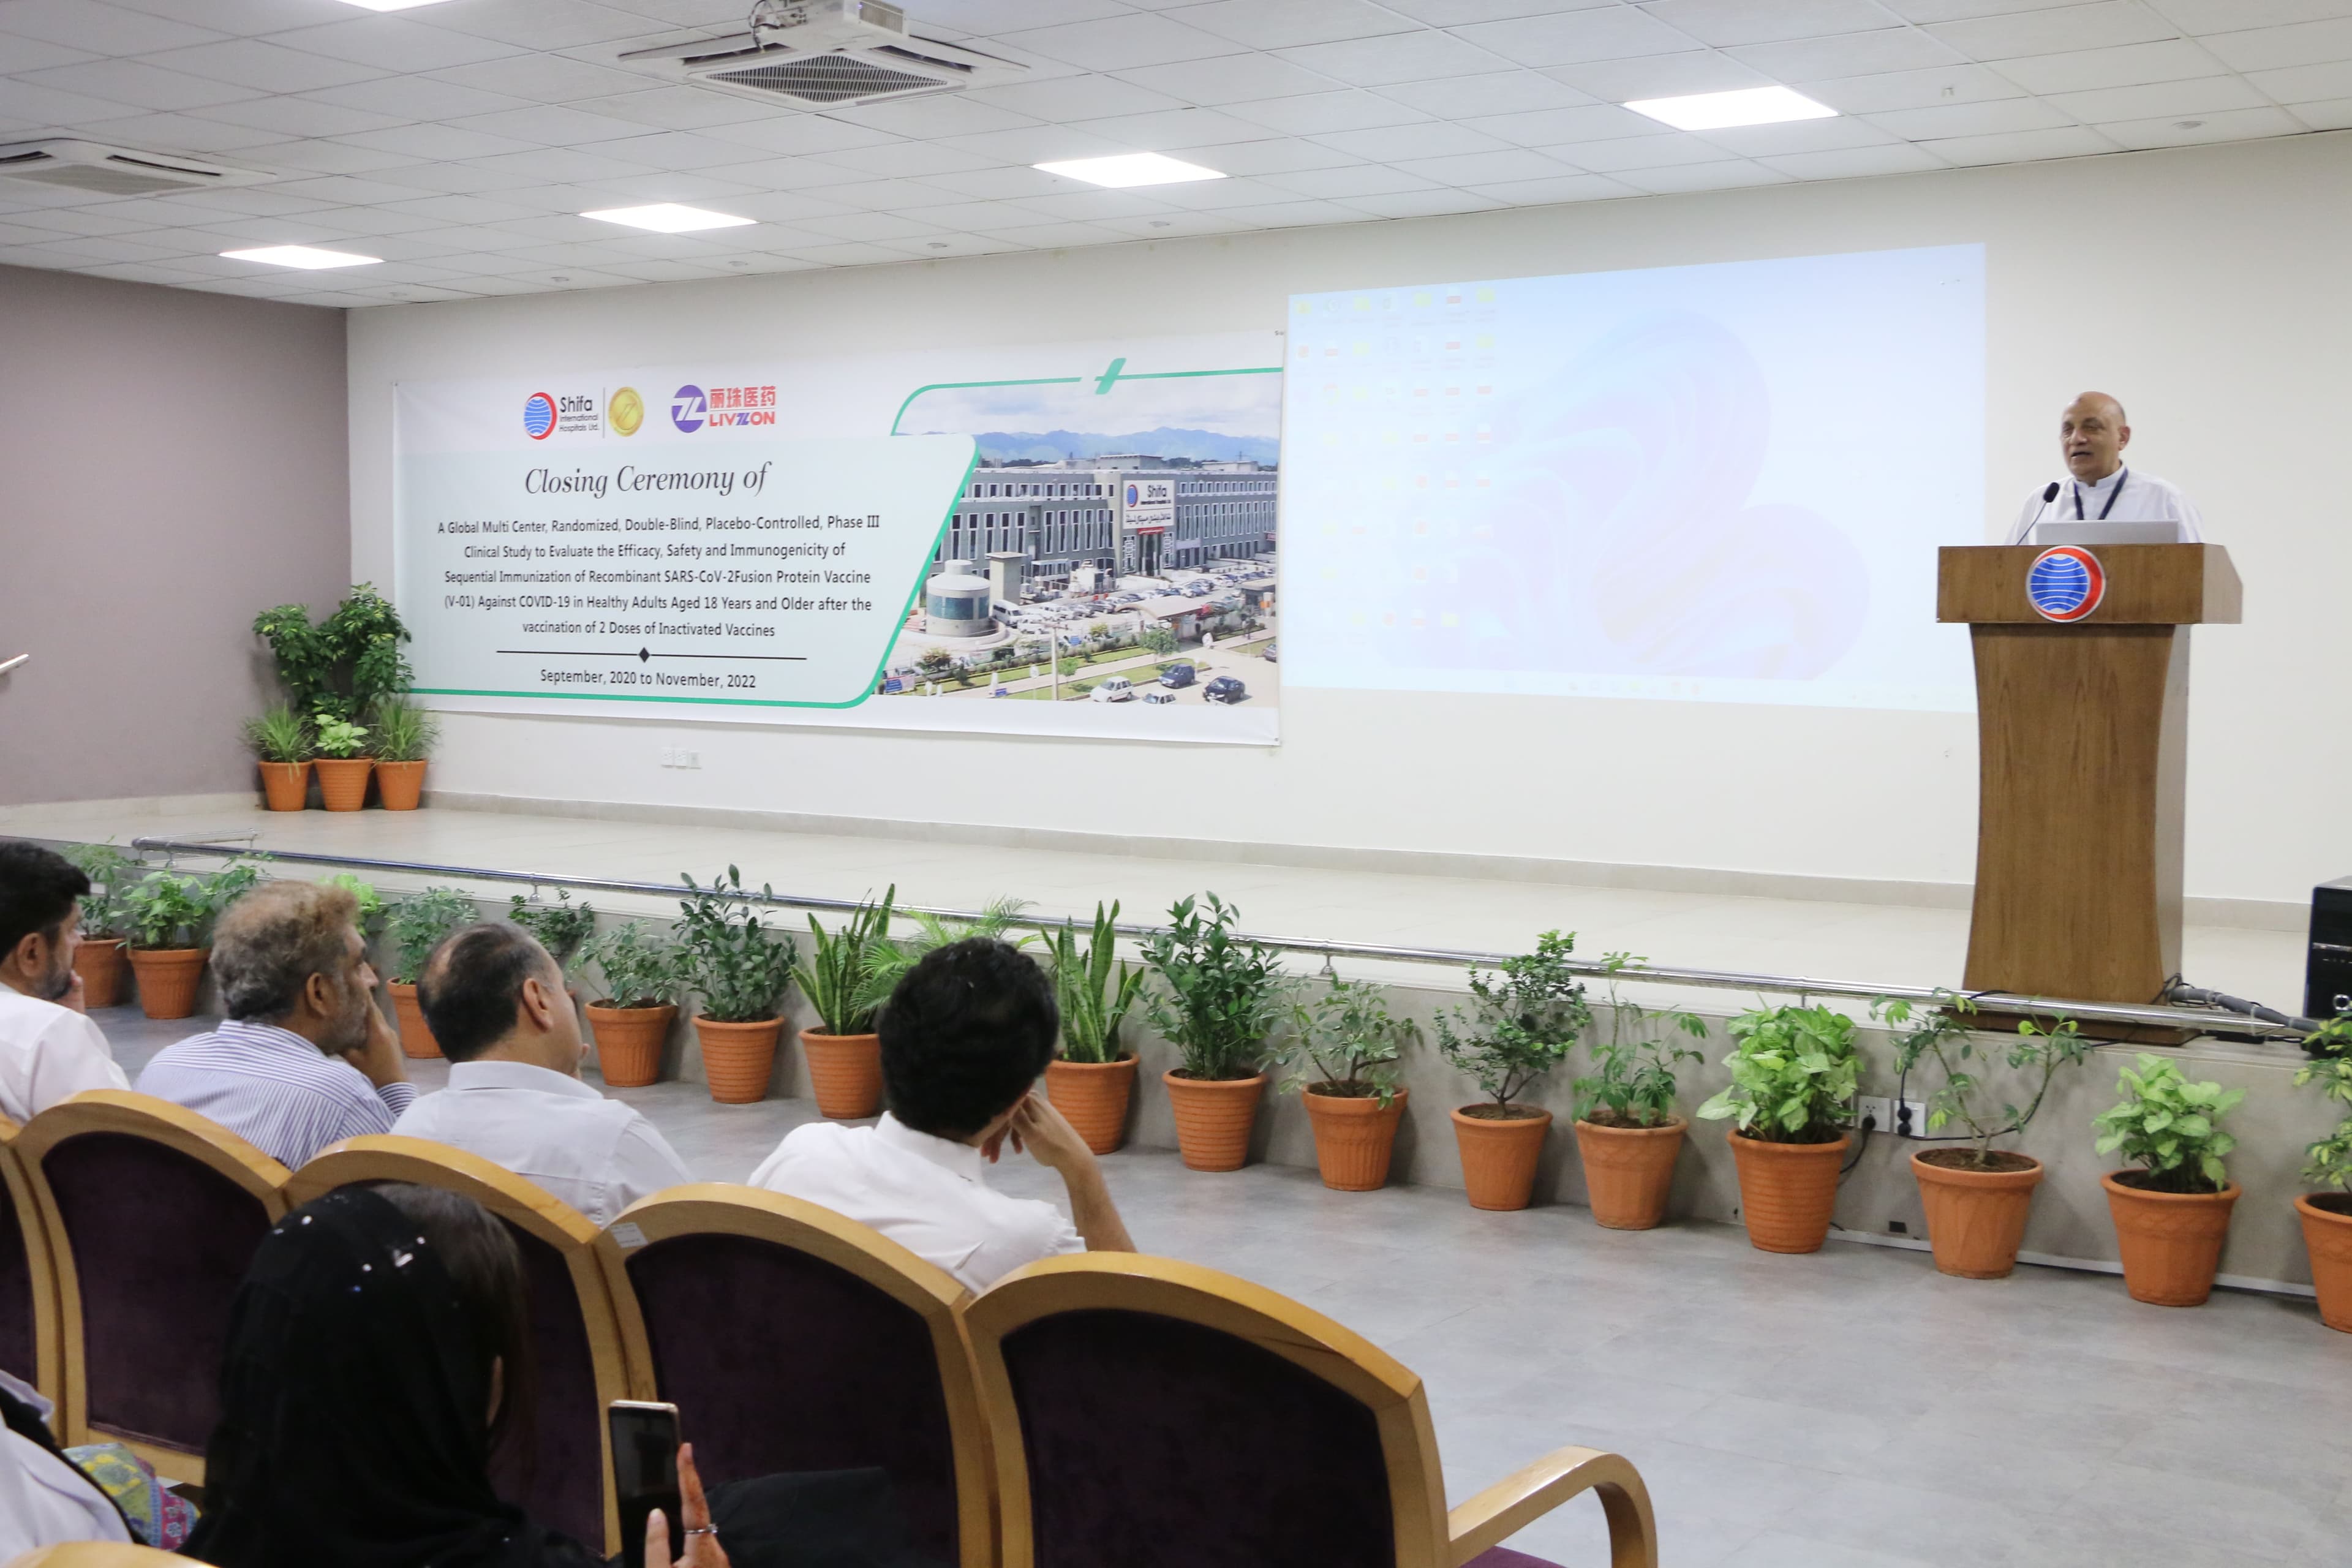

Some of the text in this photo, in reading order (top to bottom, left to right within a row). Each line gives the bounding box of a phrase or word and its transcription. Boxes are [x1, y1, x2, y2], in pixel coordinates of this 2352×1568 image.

[559, 396, 593, 413] Shifa
[710, 385, 777, 409] 丽珠医药
[524, 461, 773, 499] Closing Ceremony of
[437, 514, 880, 534] A Global Multi Center, Randomized, Double-Blind, Placebo-Controlled, Phase III
[464, 541, 846, 561] Clinical Study to Evaluate the Efficacy, Safety and Immunogenicity of
[444, 569, 871, 586] Sequential Immunization of Recombinant SARS-CoV-2Fusion Protein Vaccine
[444, 595, 872, 613] (V-01) Against COVID-19 in Healthy Adults Aged 18 Years and Older after the
[522, 620, 775, 637] vaccination of 2 Doses of Inactivated Vaccines
[540, 669, 756, 689] September, 2020 to November, 2022
